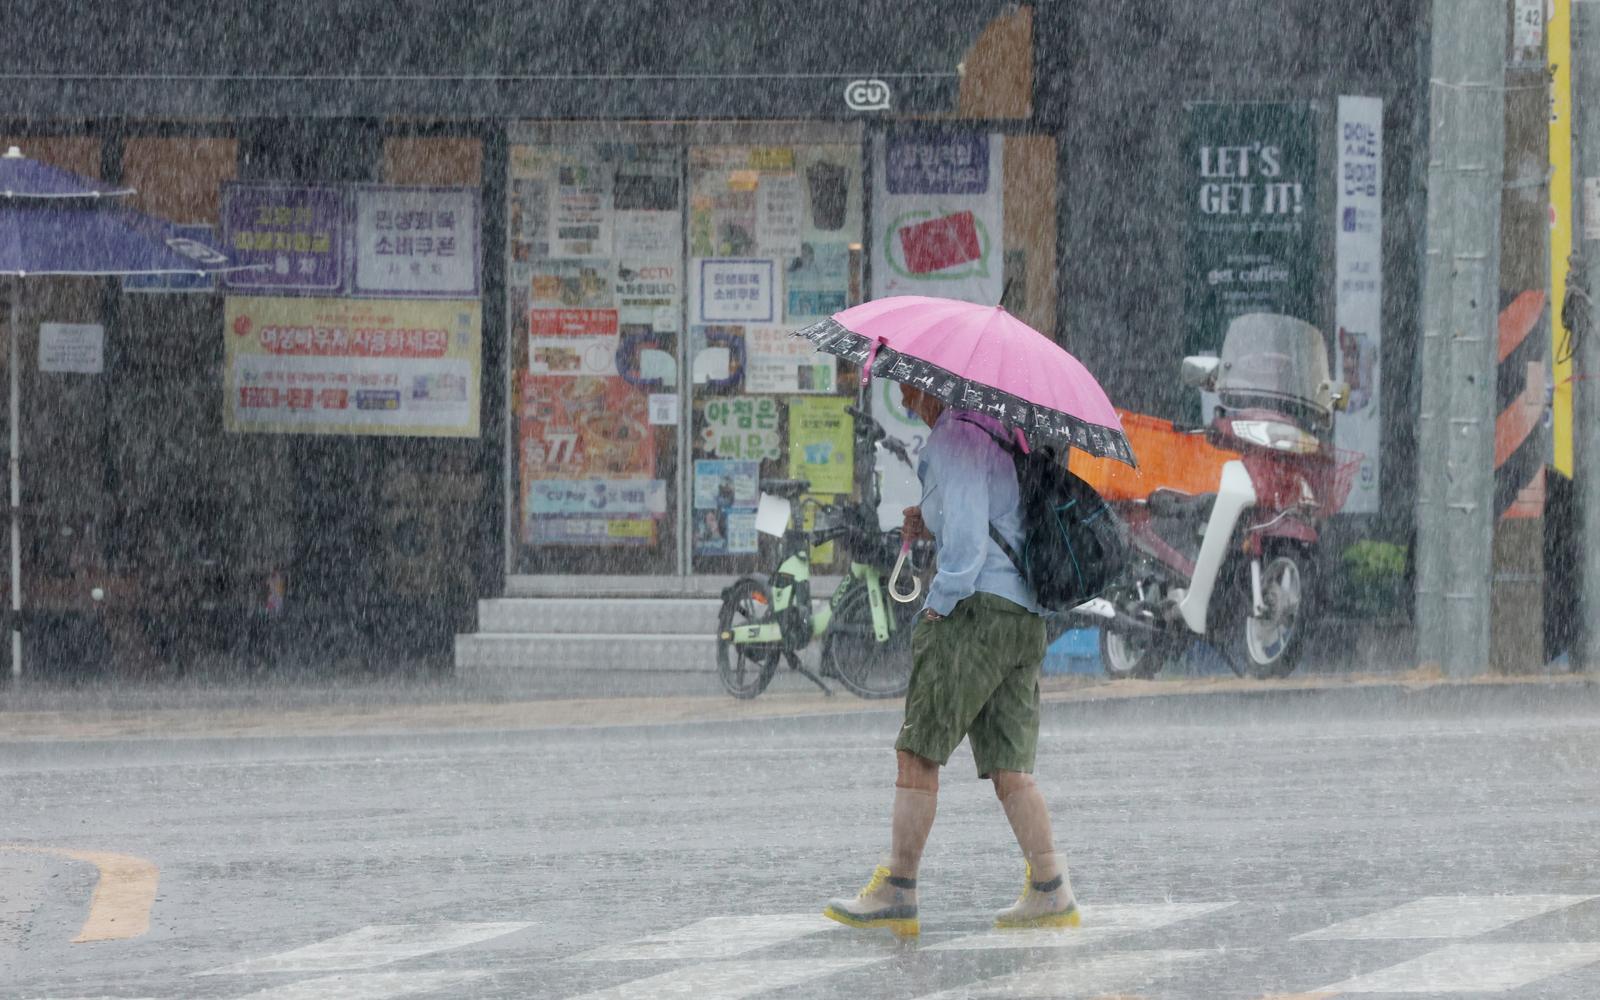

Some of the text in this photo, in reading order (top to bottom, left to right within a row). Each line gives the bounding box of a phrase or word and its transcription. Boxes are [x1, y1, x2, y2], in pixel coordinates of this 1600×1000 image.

[1525, 9, 1540, 26] 42
[1199, 142, 1280, 177] LET'S
[1199, 183, 1304, 215] GET IT!
[374, 209, 456, 232] 민생회복
[374, 235, 457, 258] 소비쿠폰
[639, 266, 675, 280] CCTV
[708, 399, 777, 430] 아침은
[543, 433, 578, 465] 77
